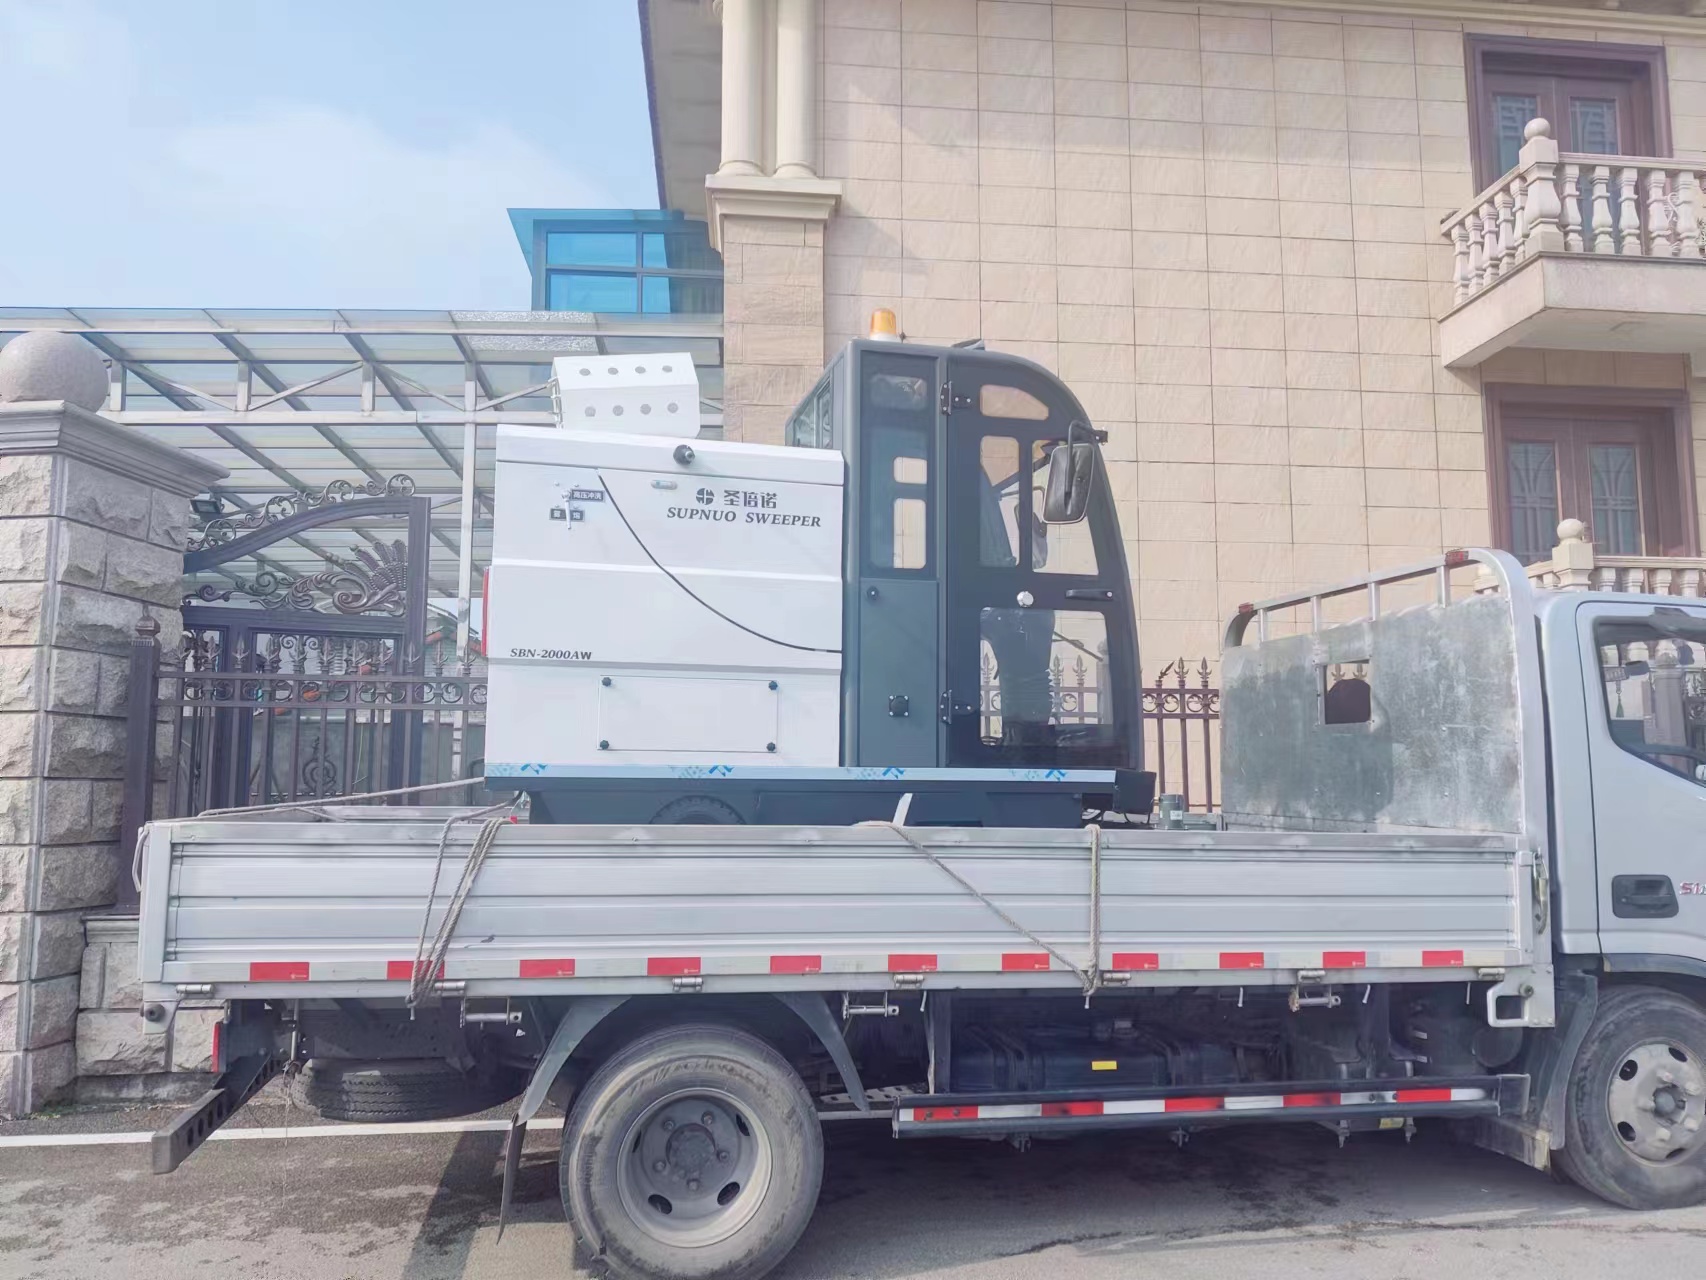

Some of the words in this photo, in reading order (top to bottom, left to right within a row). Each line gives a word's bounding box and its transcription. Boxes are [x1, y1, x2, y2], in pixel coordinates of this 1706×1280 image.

[723, 489, 777, 509] 圣倍诺
[667, 507, 737, 522] SUPNUO
[745, 512, 821, 527] SWEEPER
[510, 648, 592, 660] SBN-2000AW
